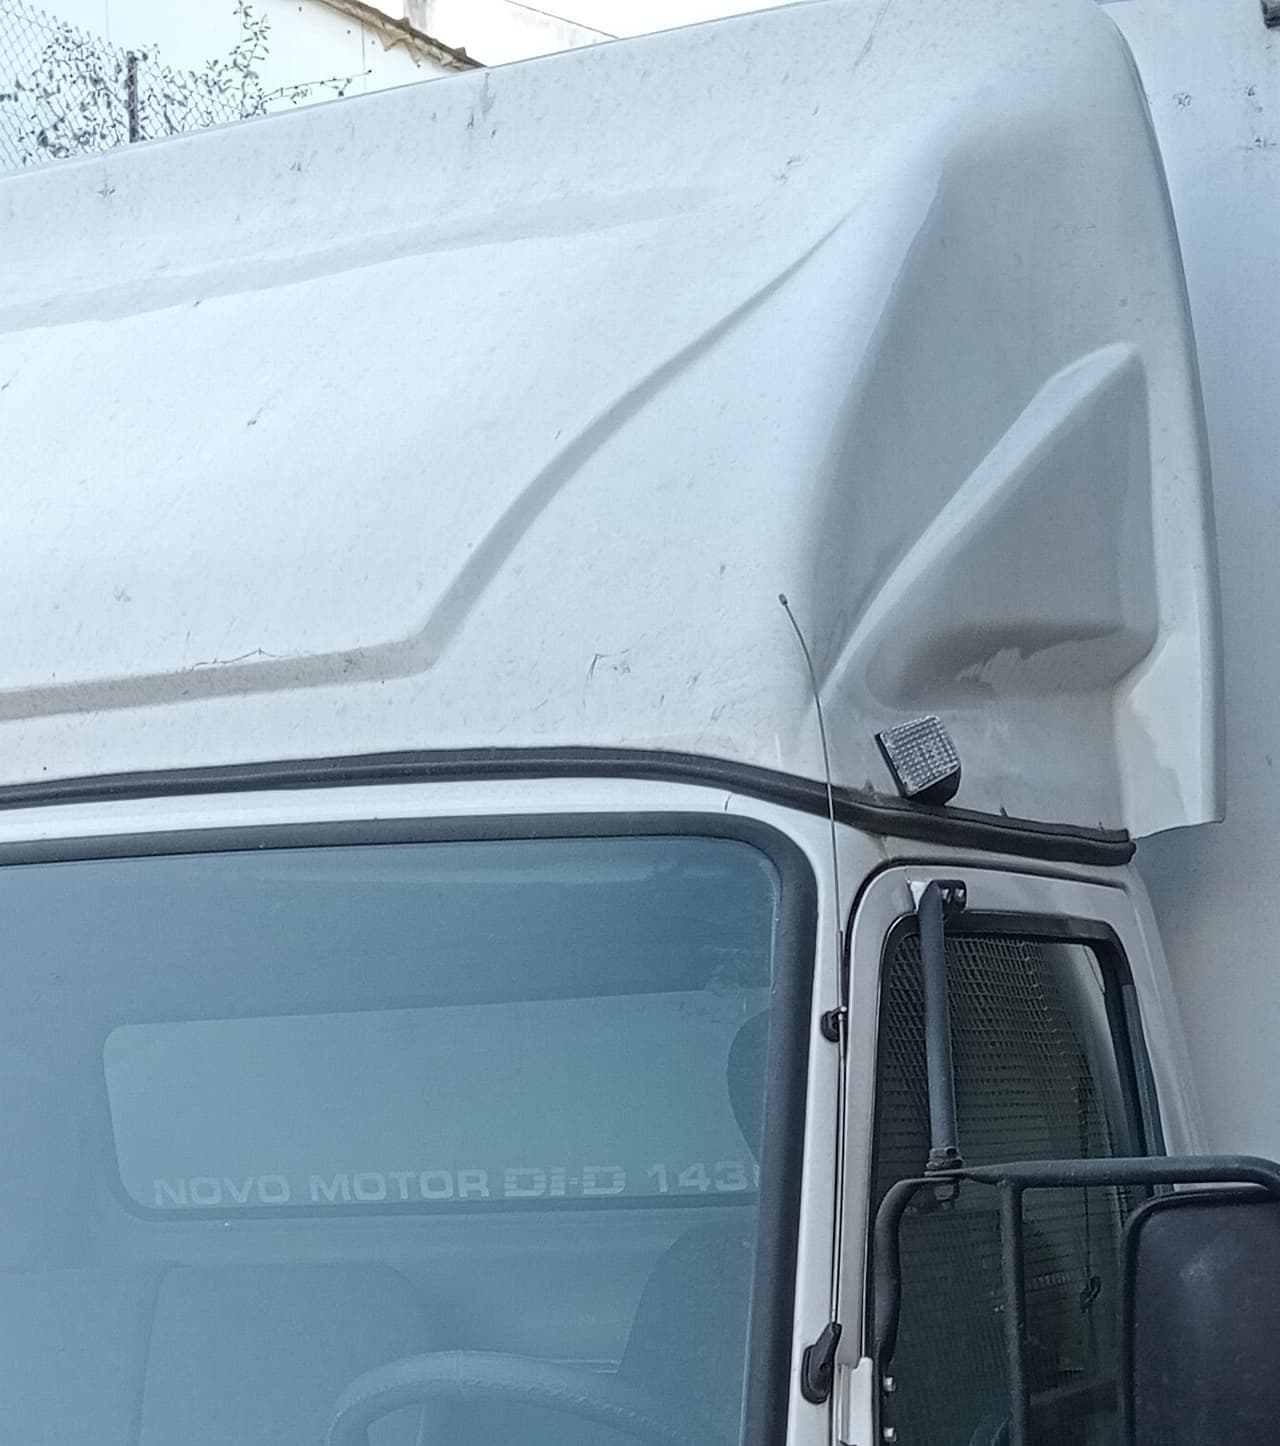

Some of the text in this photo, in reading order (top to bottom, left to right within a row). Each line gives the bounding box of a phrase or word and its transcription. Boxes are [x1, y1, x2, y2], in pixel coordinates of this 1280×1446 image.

[153, 1161, 760, 1207] NOVO MOTOR DI-D 143
